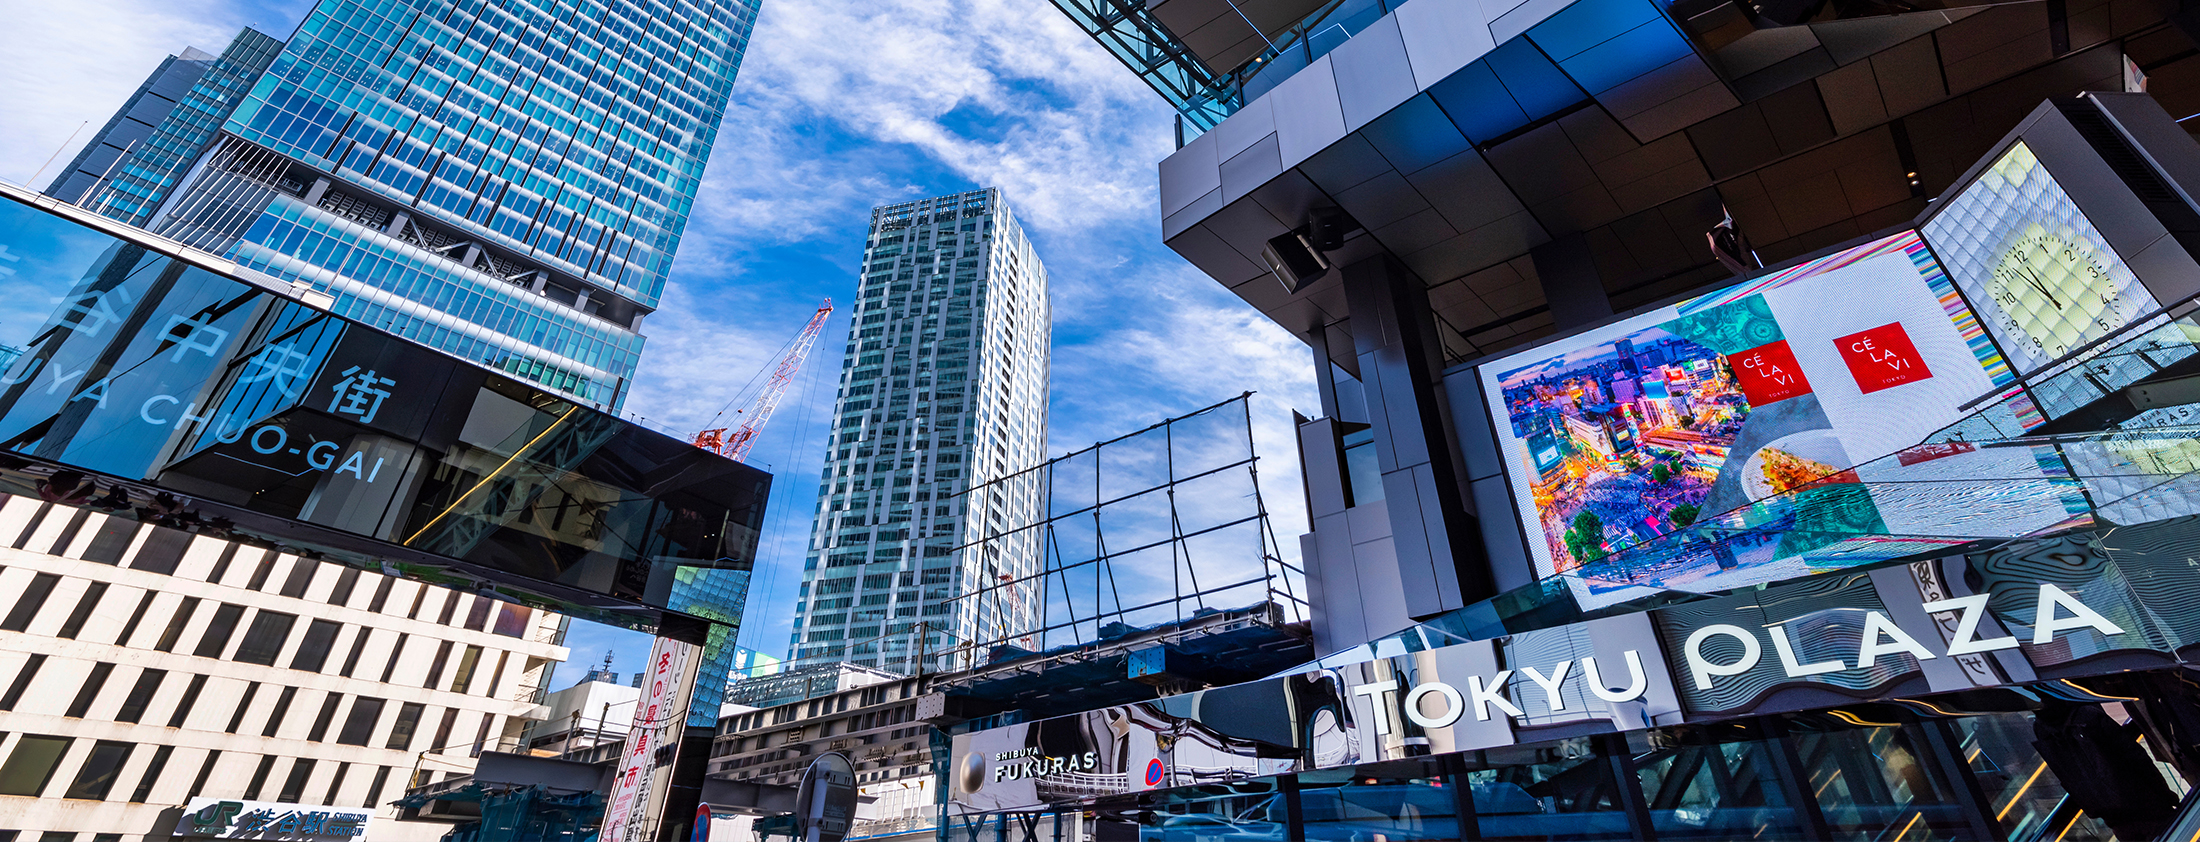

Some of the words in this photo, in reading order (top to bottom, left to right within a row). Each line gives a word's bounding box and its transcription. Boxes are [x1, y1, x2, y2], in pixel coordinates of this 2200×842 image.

[2039, 243, 2049, 254] 1
[2064, 249, 2076, 262] 2
[2013, 250, 2028, 265] 12
[2001, 269, 2015, 283] 11
[2087, 266, 2099, 279] 3
[2002, 291, 2016, 306] 10
[2100, 293, 2110, 305] 4
[2011, 319, 2021, 331] 9
[2097, 318, 2110, 332] 5
[1851, 336, 1876, 353] CÉ
[2032, 336, 2043, 348] 8
[1869, 349, 1897, 363] LA
[2056, 345, 2066, 356] 7
[1743, 352, 1764, 369] CÉ
[1887, 358, 1911, 371] VI
[1759, 364, 1783, 378] LA
[1774, 373, 1794, 386] VI
[1882, 374, 1906, 384] TOKYO
[1769, 389, 1790, 398] TOKYO
[140, 393, 385, 484] CHUO-GAI
[1355, 649, 1649, 736] TOKYU
[1684, 582, 2126, 690] PLAZA
[995, 746, 1039, 761] SHIBUYA
[994, 752, 1098, 783] FUKURAS
[193, 800, 244, 826] JR
[333, 811, 368, 823] SHIBUYA
[246, 807, 331, 835] 渋谷駅
[327, 824, 365, 837] STATION
